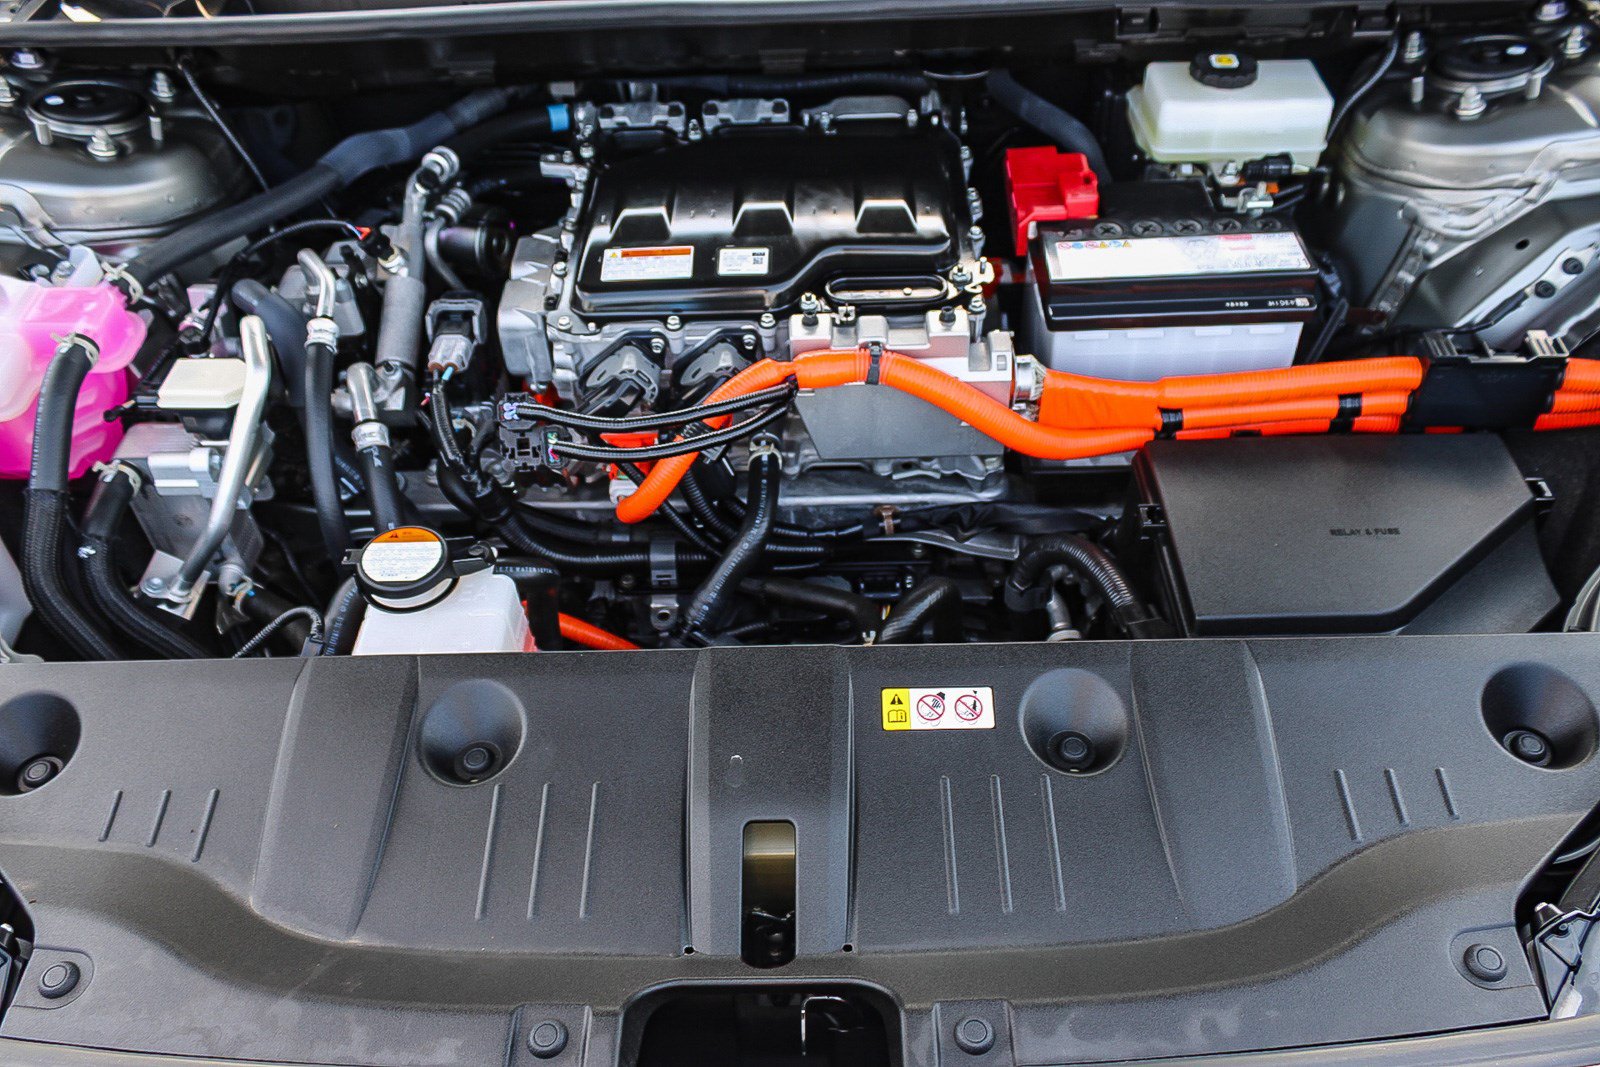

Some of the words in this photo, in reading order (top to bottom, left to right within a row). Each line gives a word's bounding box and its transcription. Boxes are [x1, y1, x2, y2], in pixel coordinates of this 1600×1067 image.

[1329, 528, 1361, 536] RELAY
[1365, 528, 1372, 536] &
[1374, 527, 1400, 535] FUSE
